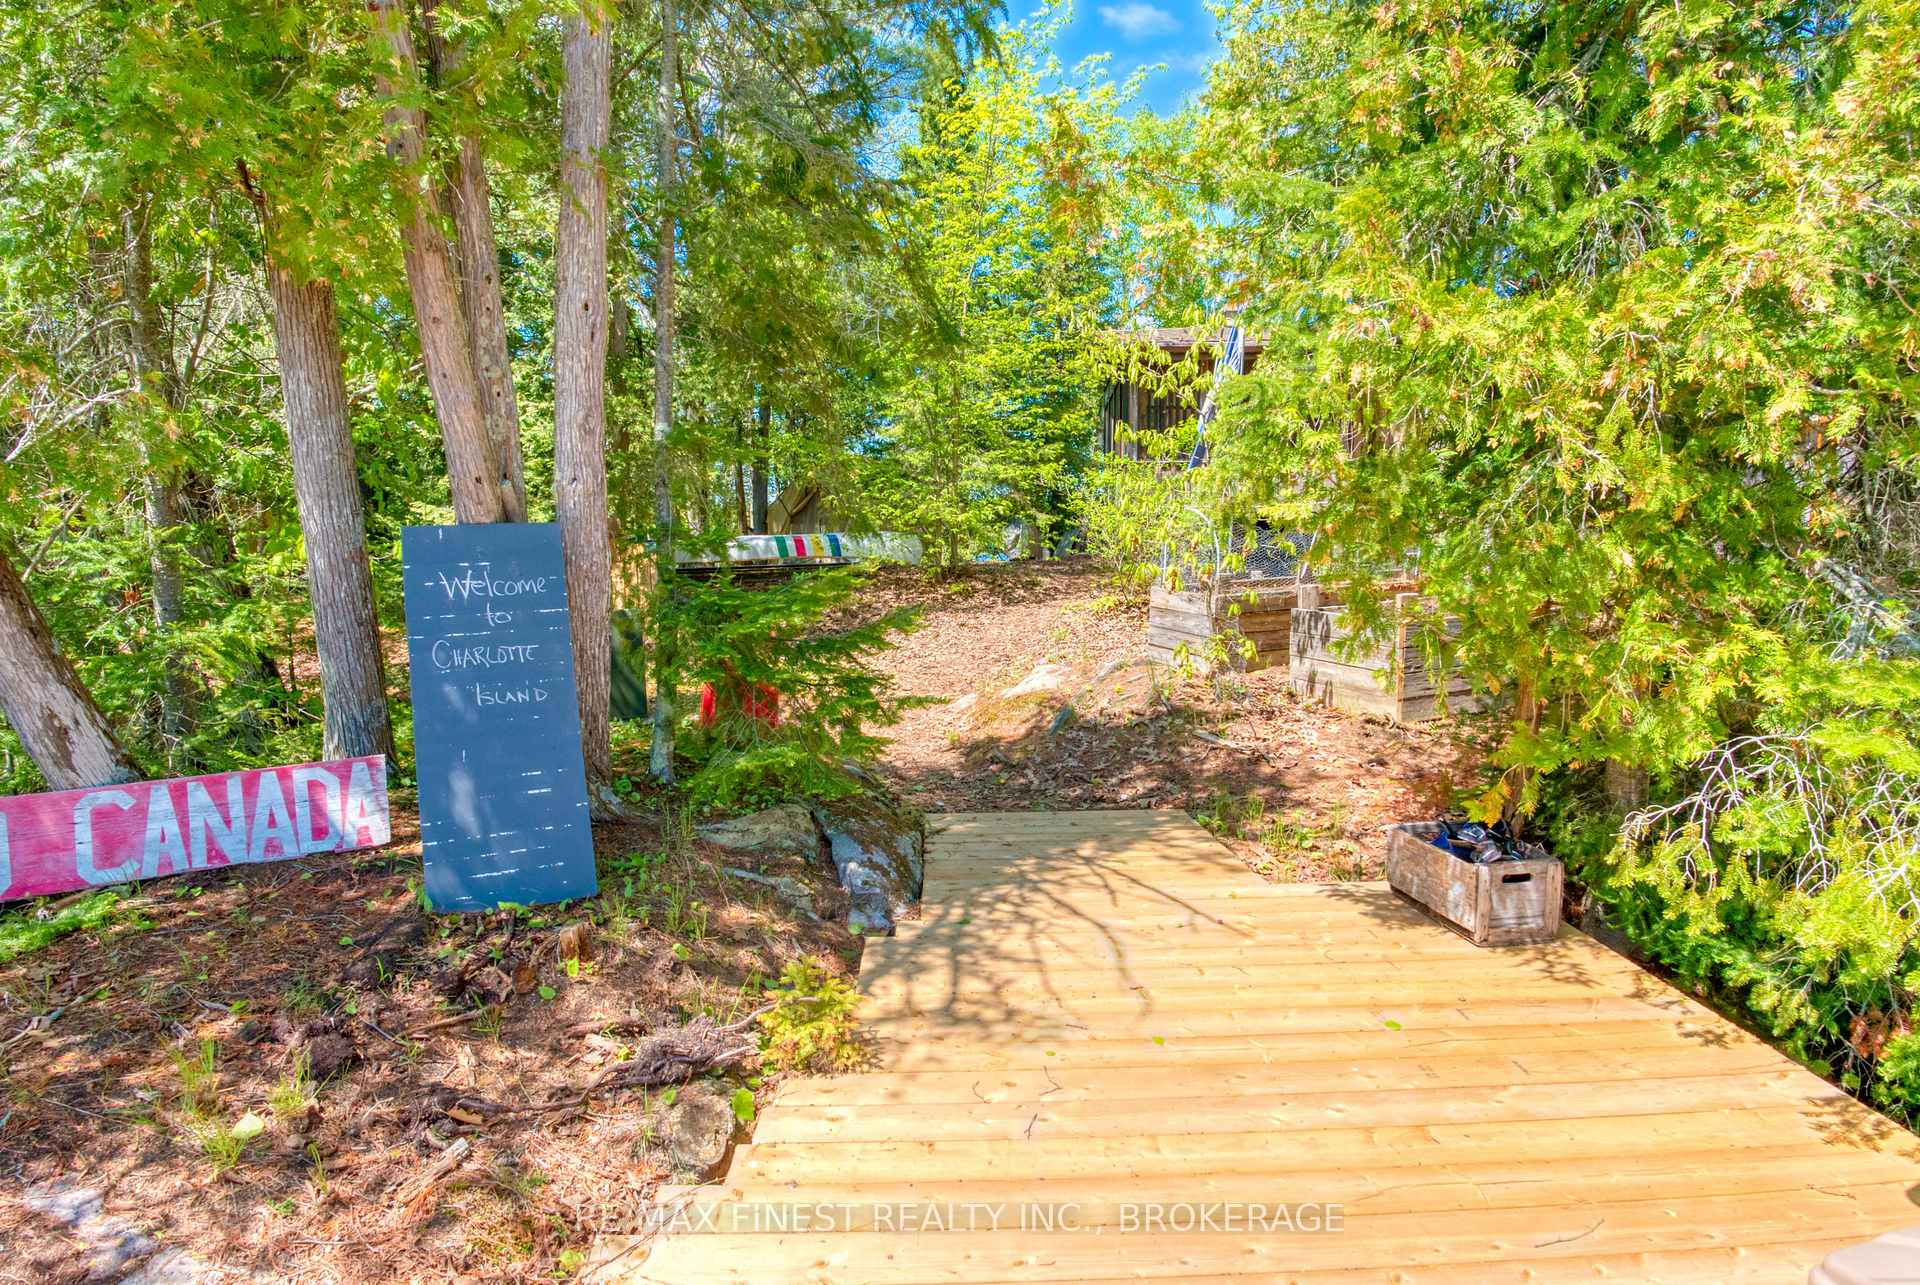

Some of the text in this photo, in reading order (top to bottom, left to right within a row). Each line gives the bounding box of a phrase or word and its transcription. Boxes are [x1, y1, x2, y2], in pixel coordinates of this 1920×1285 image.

[438, 570, 547, 600] Welcome
[483, 602, 512, 627] to
[432, 640, 540, 669] CHARLOTTE
[476, 682, 548, 706] ISLAND
[74, 762, 384, 886] CANADA
